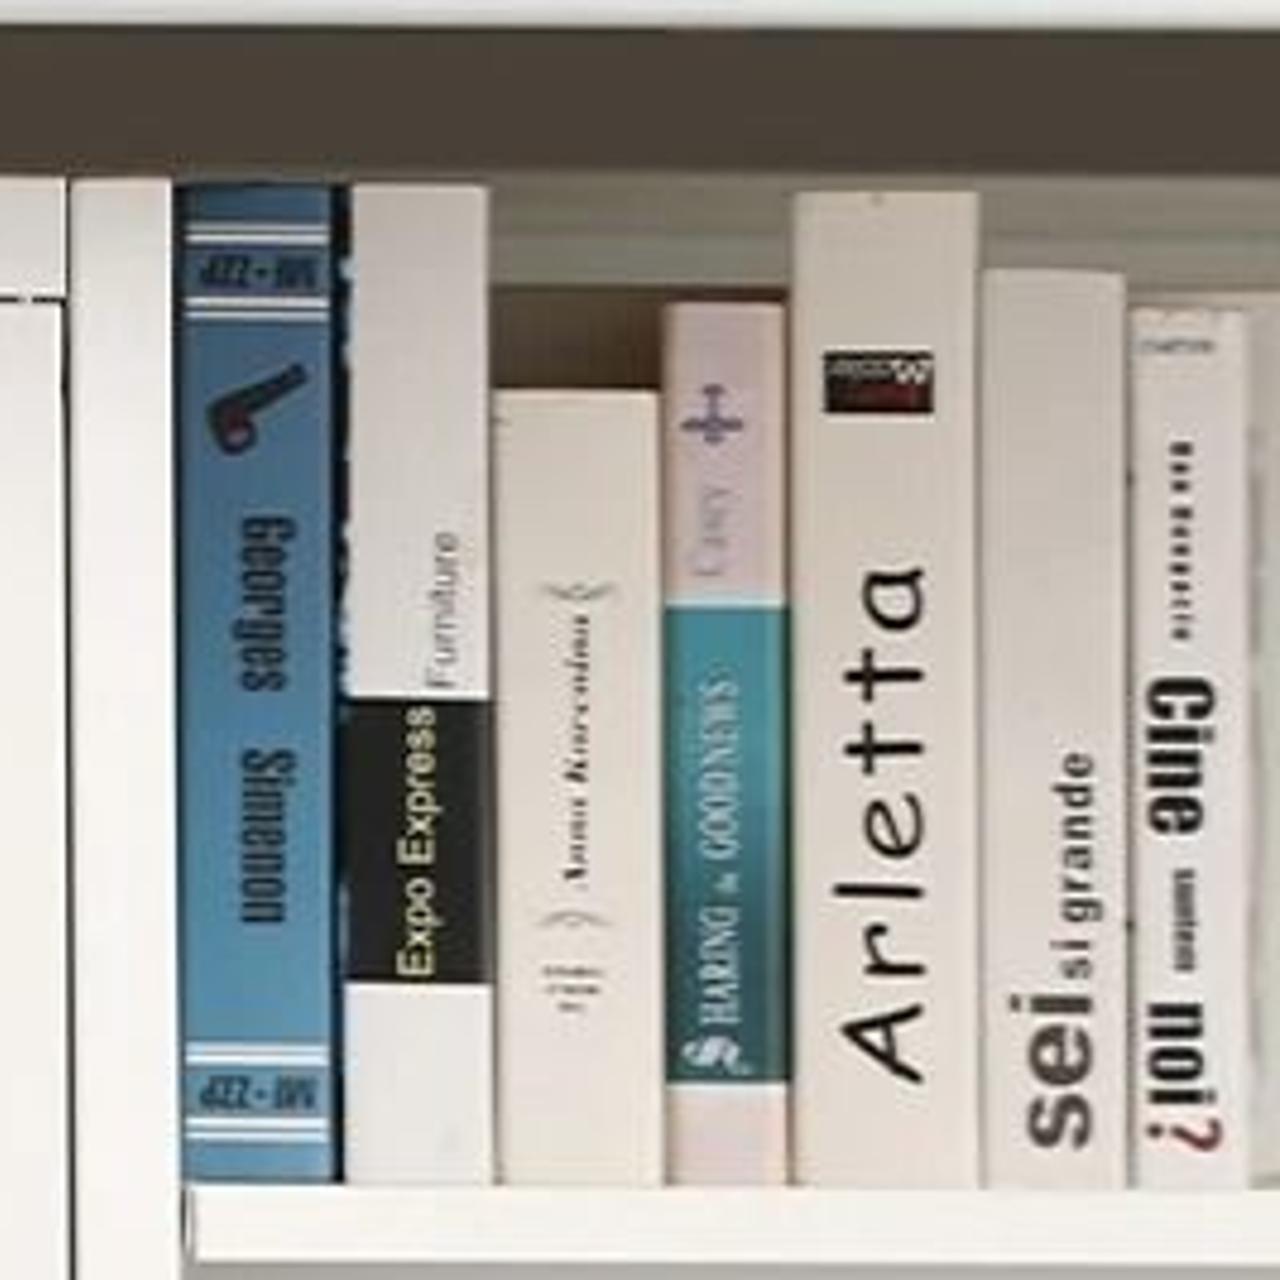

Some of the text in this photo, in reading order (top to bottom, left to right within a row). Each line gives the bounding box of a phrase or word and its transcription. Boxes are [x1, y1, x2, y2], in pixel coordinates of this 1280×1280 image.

[231, 515, 298, 924] Georges Simenon
[424, 531, 461, 689] Furniture
[396, 705, 447, 976] Expo Express
[832, 567, 926, 1085] Arletta
[1146, 677, 1216, 835] Cine
[1009, 752, 1103, 1149] sei si grande
[1146, 1002, 1223, 1152] noi?
